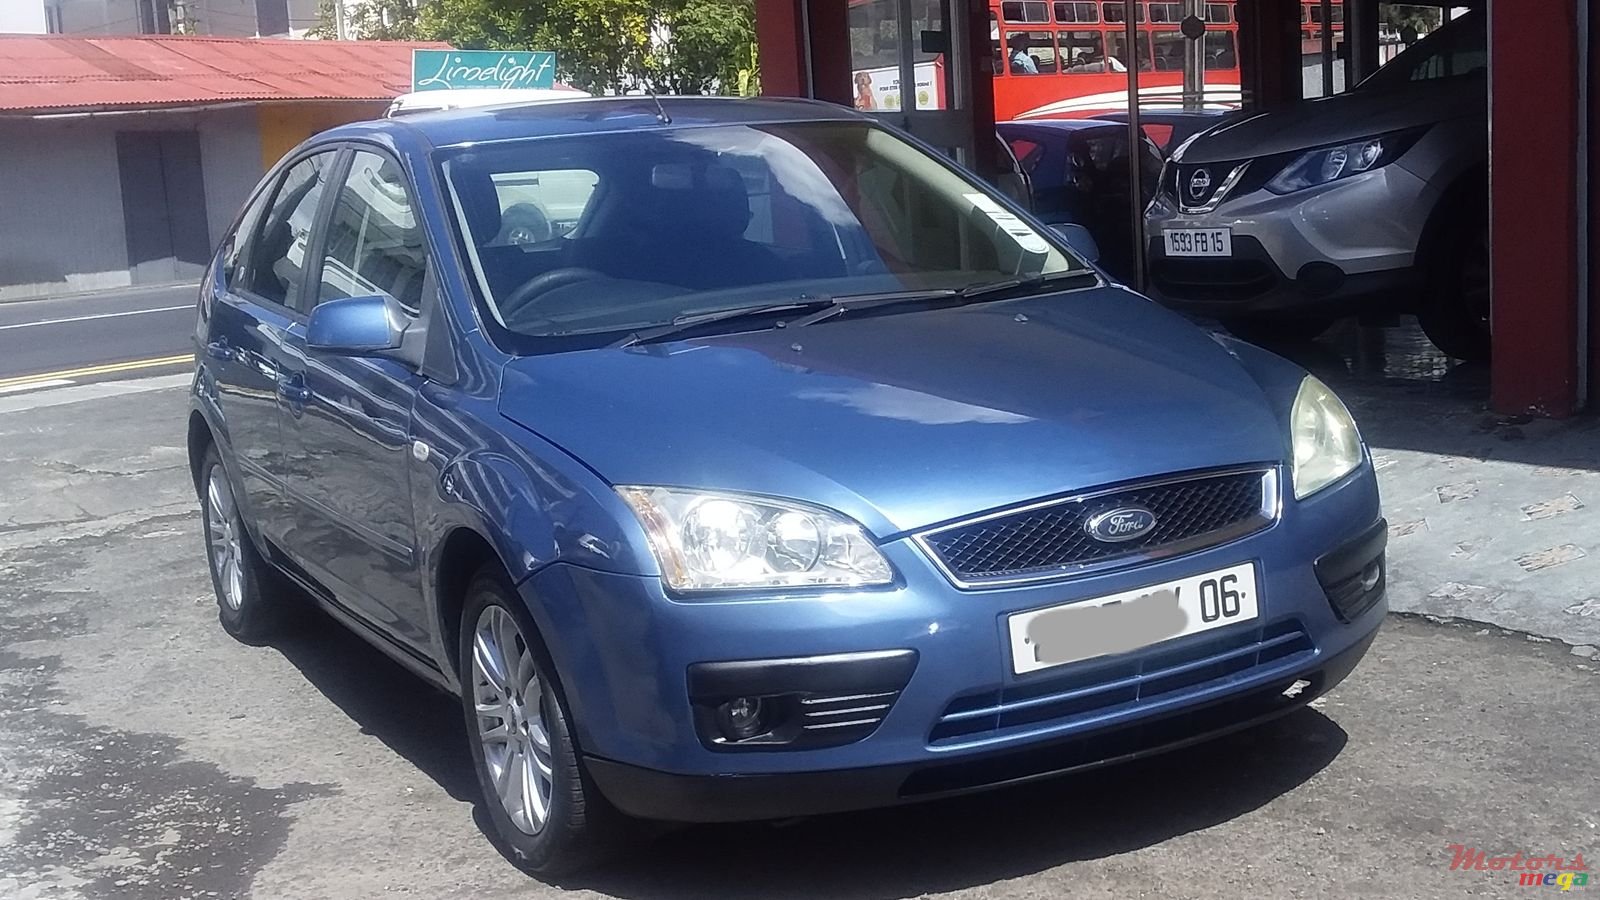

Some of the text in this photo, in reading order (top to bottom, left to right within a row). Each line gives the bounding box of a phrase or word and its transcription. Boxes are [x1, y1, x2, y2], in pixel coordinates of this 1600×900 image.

[417, 53, 552, 89] Limelight
[1170, 231, 1224, 252] 1593 FB 15
[1108, 513, 1143, 535] Ford
[1199, 574, 1240, 623] 06
